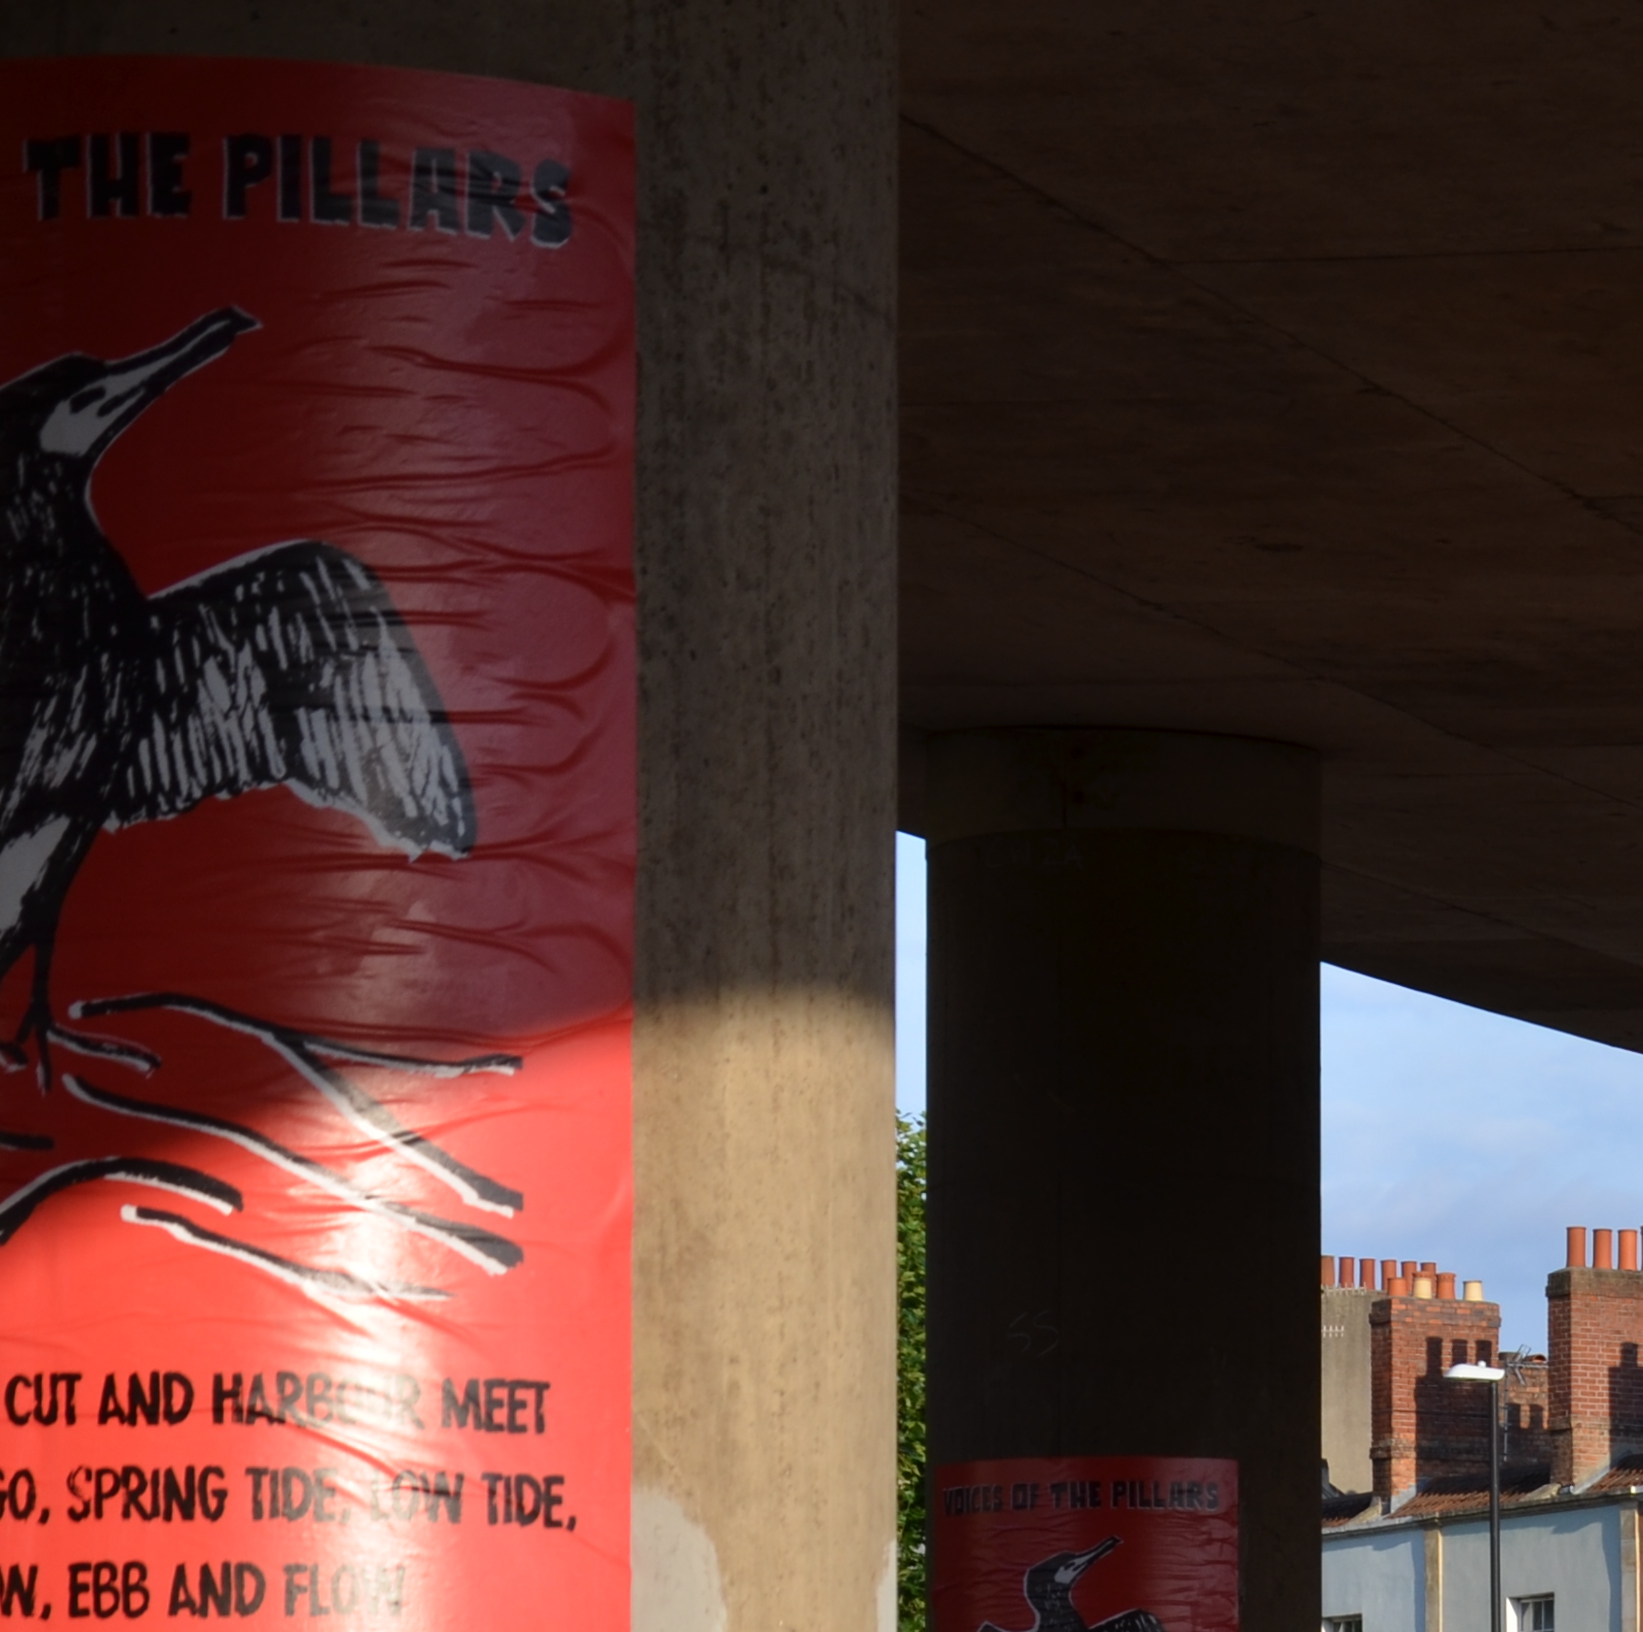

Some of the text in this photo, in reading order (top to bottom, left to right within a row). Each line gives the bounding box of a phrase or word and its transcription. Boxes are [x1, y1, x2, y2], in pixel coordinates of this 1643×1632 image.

[23, 132, 573, 249] THE PILLARS
[4, 1372, 82, 1426] CUT
[98, 1371, 194, 1426] AND
[441, 1378, 550, 1434] MEET
[66, 1465, 228, 1523] SPRING
[245, 1466, 350, 1525] TIDE,
[369, 1468, 465, 1525] LOW
[481, 1472, 577, 1531] TIDE,
[943, 1481, 1219, 1516] VOICES OF THE PILLARS
[68, 1561, 149, 1619] EBB
[168, 1561, 266, 1619] AND
[283, 1562, 406, 1619] FLOW
